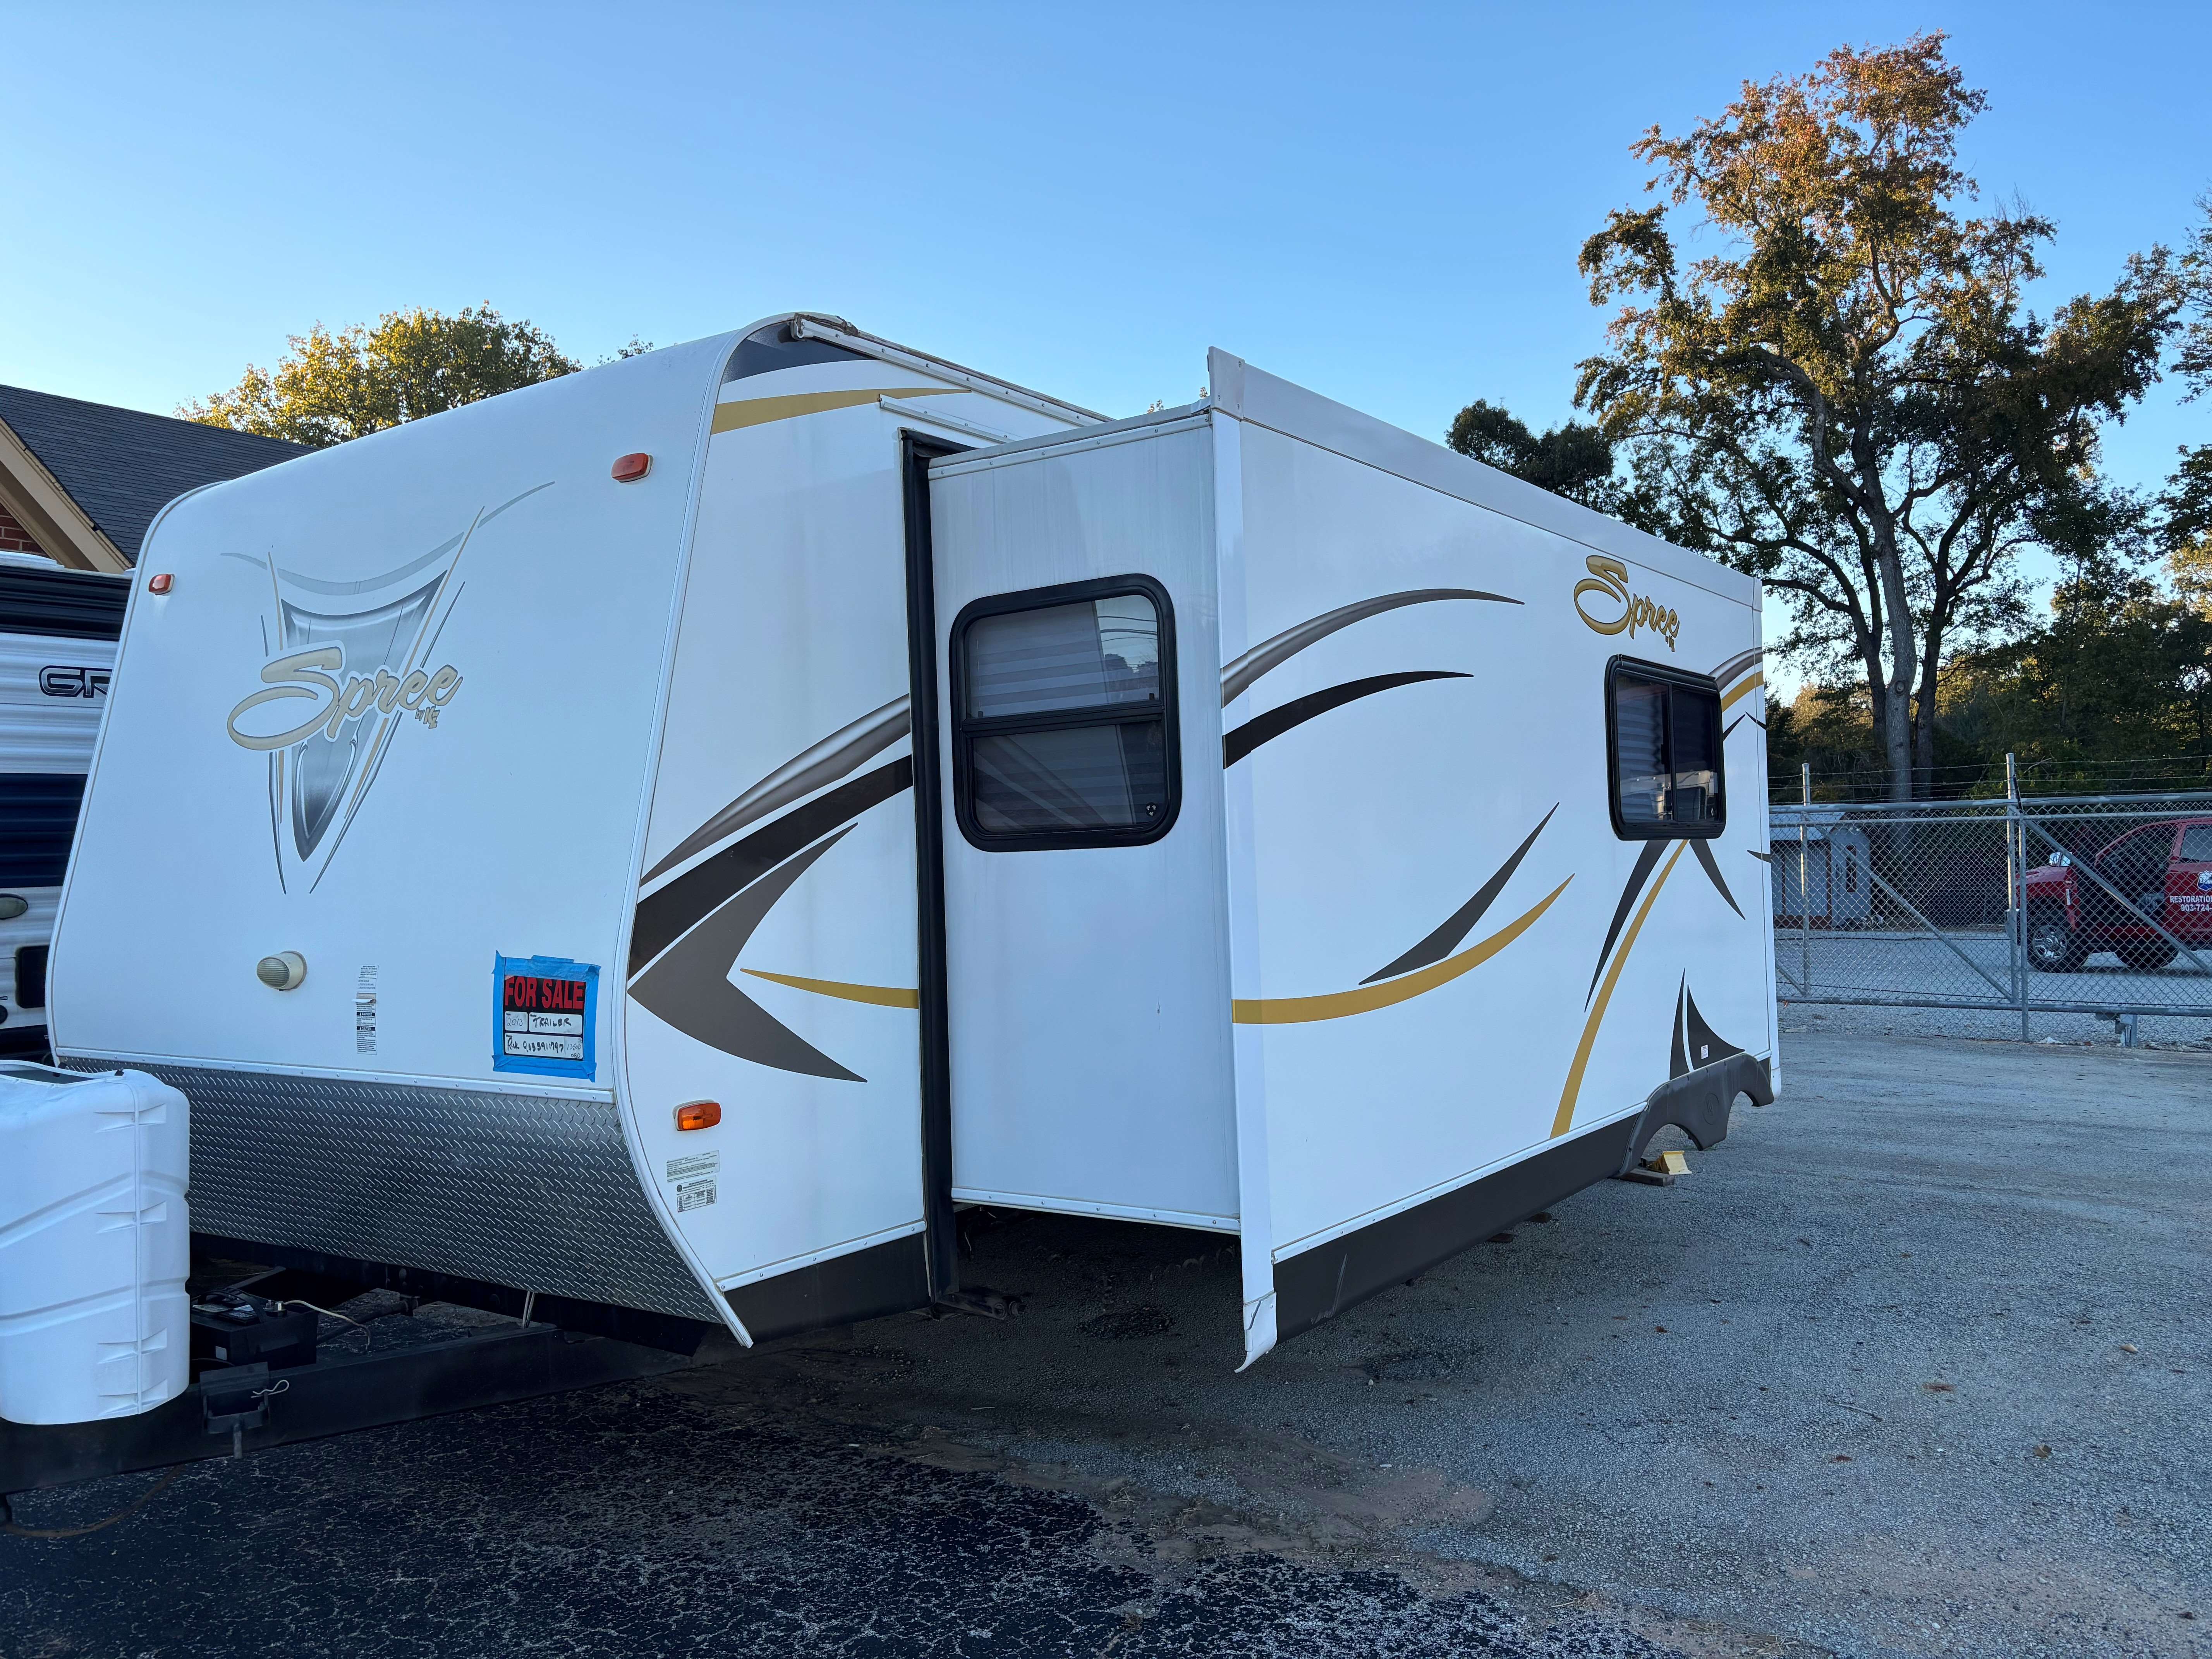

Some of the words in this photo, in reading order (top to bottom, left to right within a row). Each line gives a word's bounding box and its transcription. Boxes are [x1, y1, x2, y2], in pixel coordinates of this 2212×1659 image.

[1574, 555, 1680, 639] Spree
[227, 646, 464, 750] Spree
[415, 708, 425, 721] by
[505, 976, 537, 1007] FOR
[542, 978, 585, 1009] SALE
